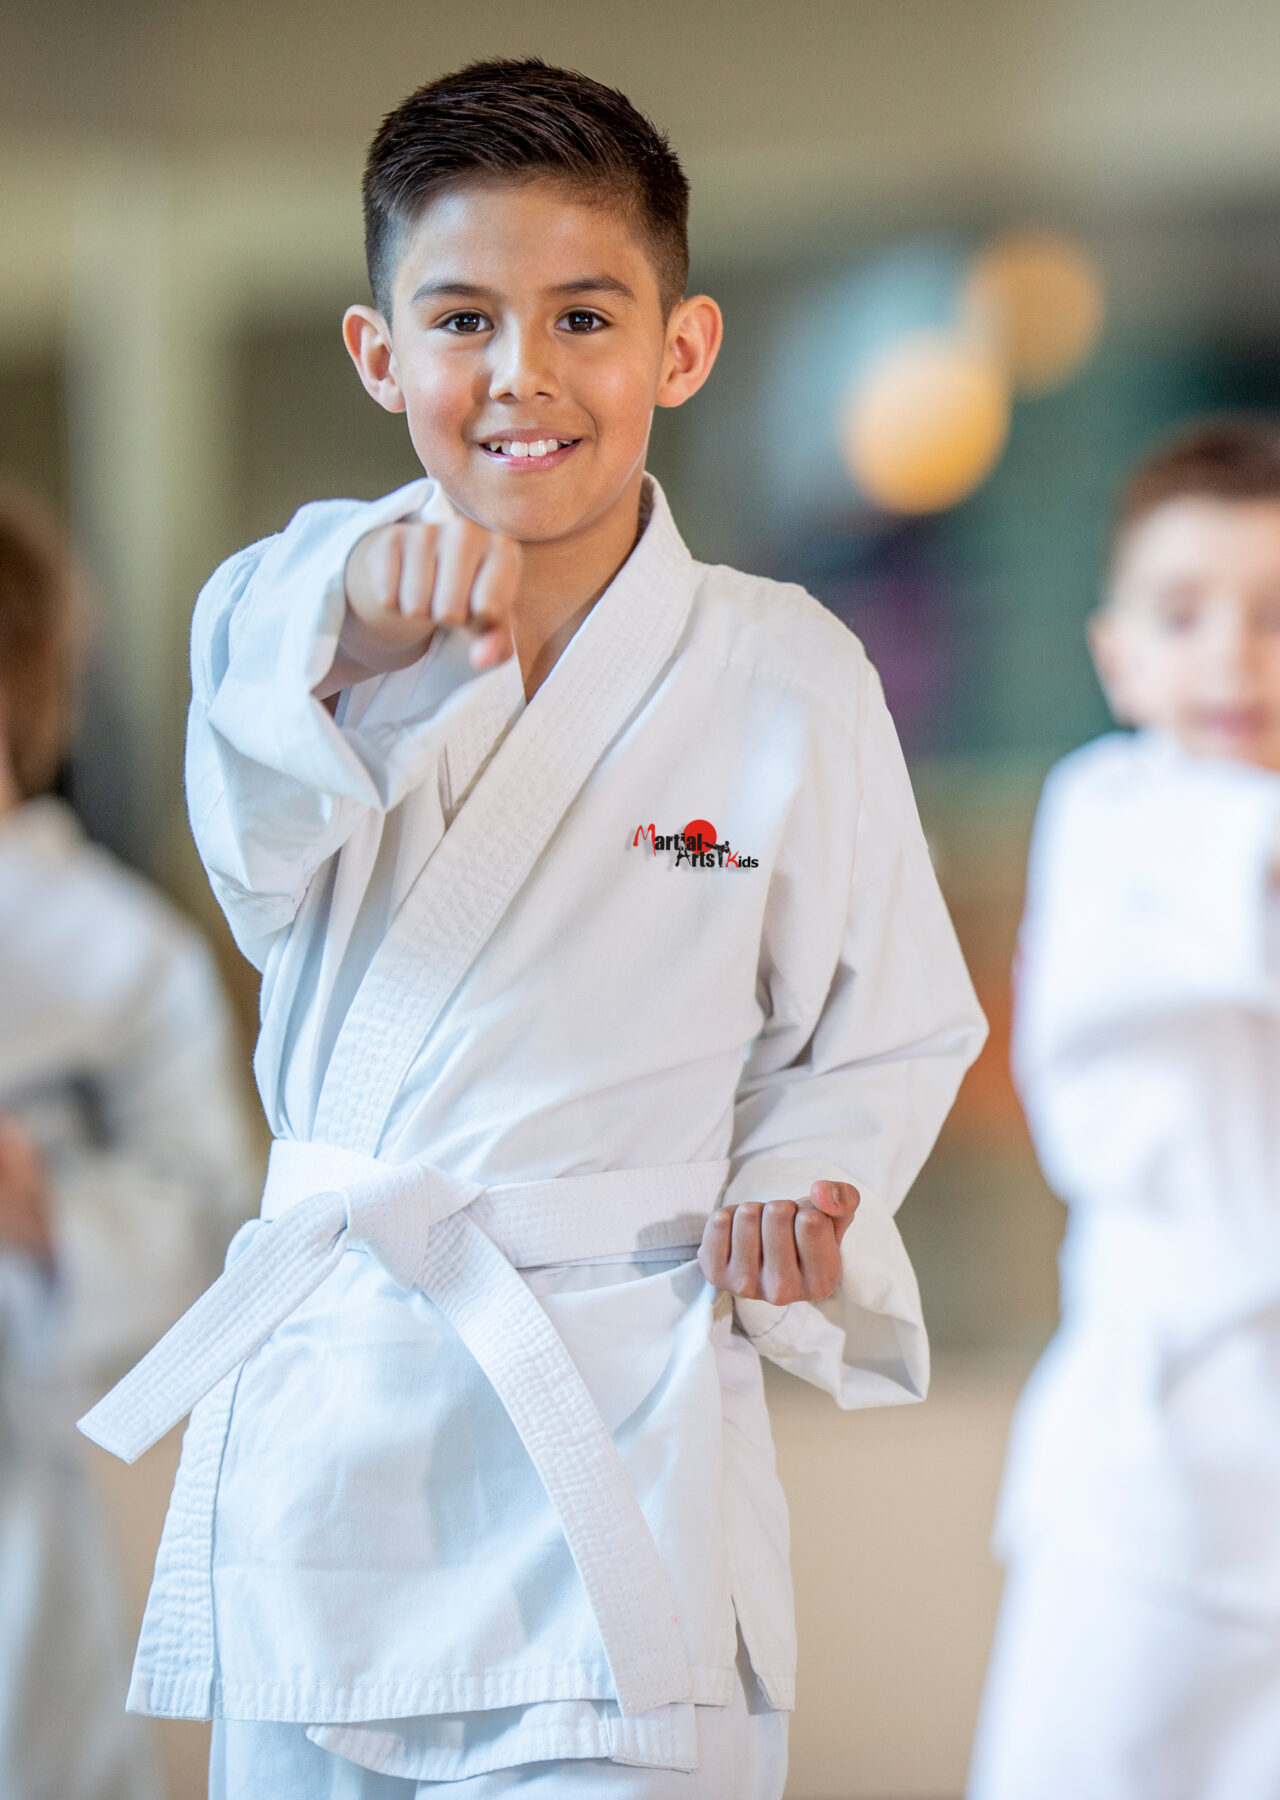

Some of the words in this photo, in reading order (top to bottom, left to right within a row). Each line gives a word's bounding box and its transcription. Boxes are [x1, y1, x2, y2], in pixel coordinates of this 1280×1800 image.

[633, 823, 702, 856] Martial
[675, 847, 715, 867] Arts
[725, 850, 759, 868] Kids
